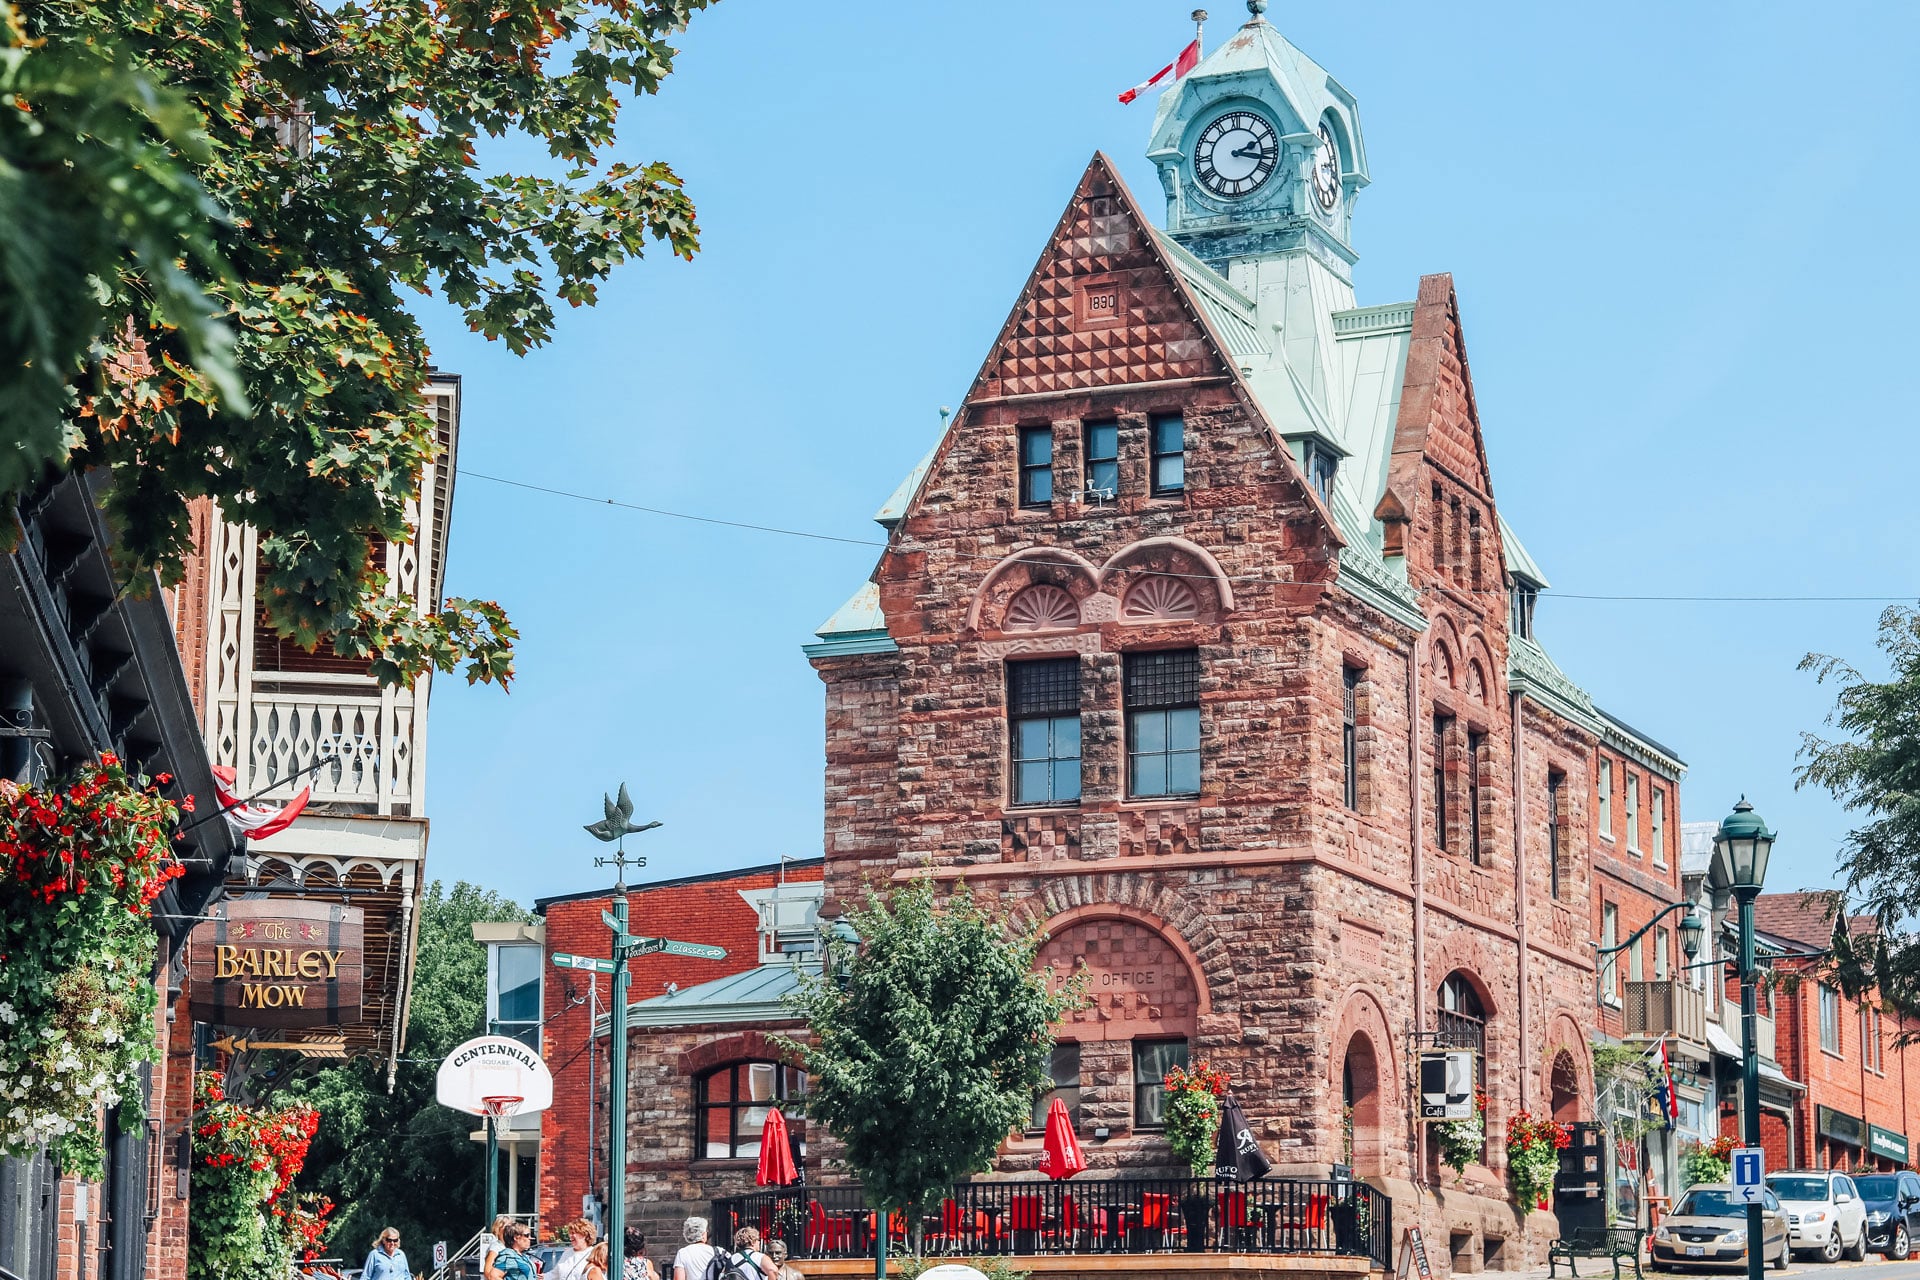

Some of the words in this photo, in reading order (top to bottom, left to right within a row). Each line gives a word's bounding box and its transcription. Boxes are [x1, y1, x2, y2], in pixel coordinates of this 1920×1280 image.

[1089, 294, 1115, 310] 1890
[594, 857, 604, 867] N
[638, 857, 647, 867] S
[259, 921, 292, 940] The
[672, 944, 706, 956] Classes
[215, 945, 345, 979] BARLEY
[1056, 974, 1094, 989] POT
[1102, 971, 1155, 986] OFFICE
[239, 983, 308, 1009] MOW
[453, 1044, 537, 1072] CENTENNIAL
